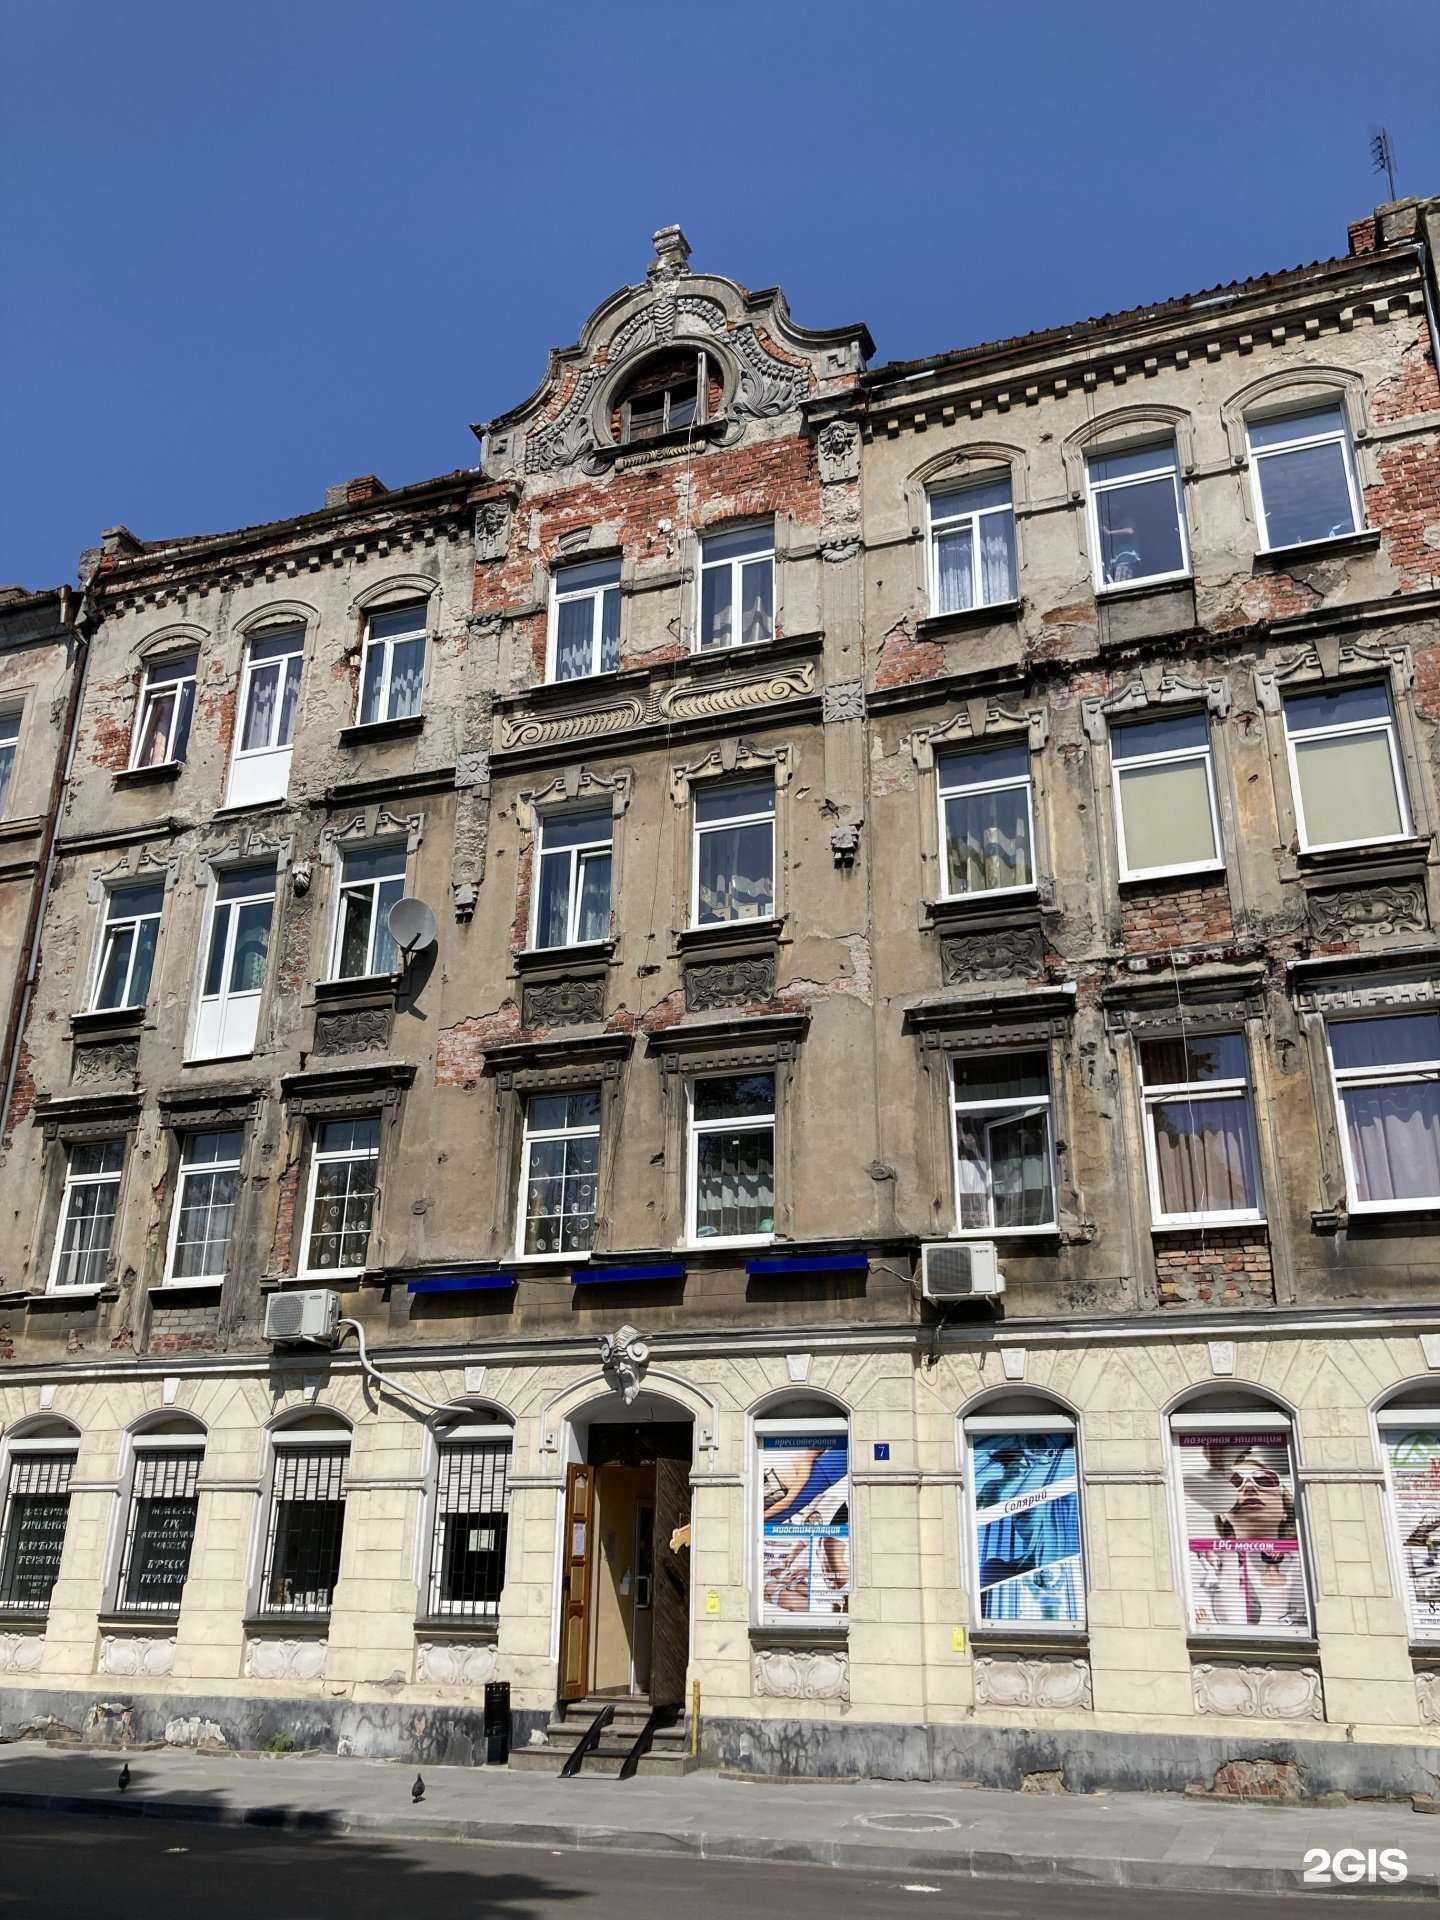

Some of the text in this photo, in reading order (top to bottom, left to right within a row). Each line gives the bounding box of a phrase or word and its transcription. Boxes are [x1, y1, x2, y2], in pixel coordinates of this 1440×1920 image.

[1183, 1436, 1231, 1445] лазерная
[877, 1446, 886, 1457] 7
[1004, 1490, 1047, 1513] Солярий
[772, 1526, 840, 1536] миостимуляция
[1212, 1540, 1231, 1551] LPG
